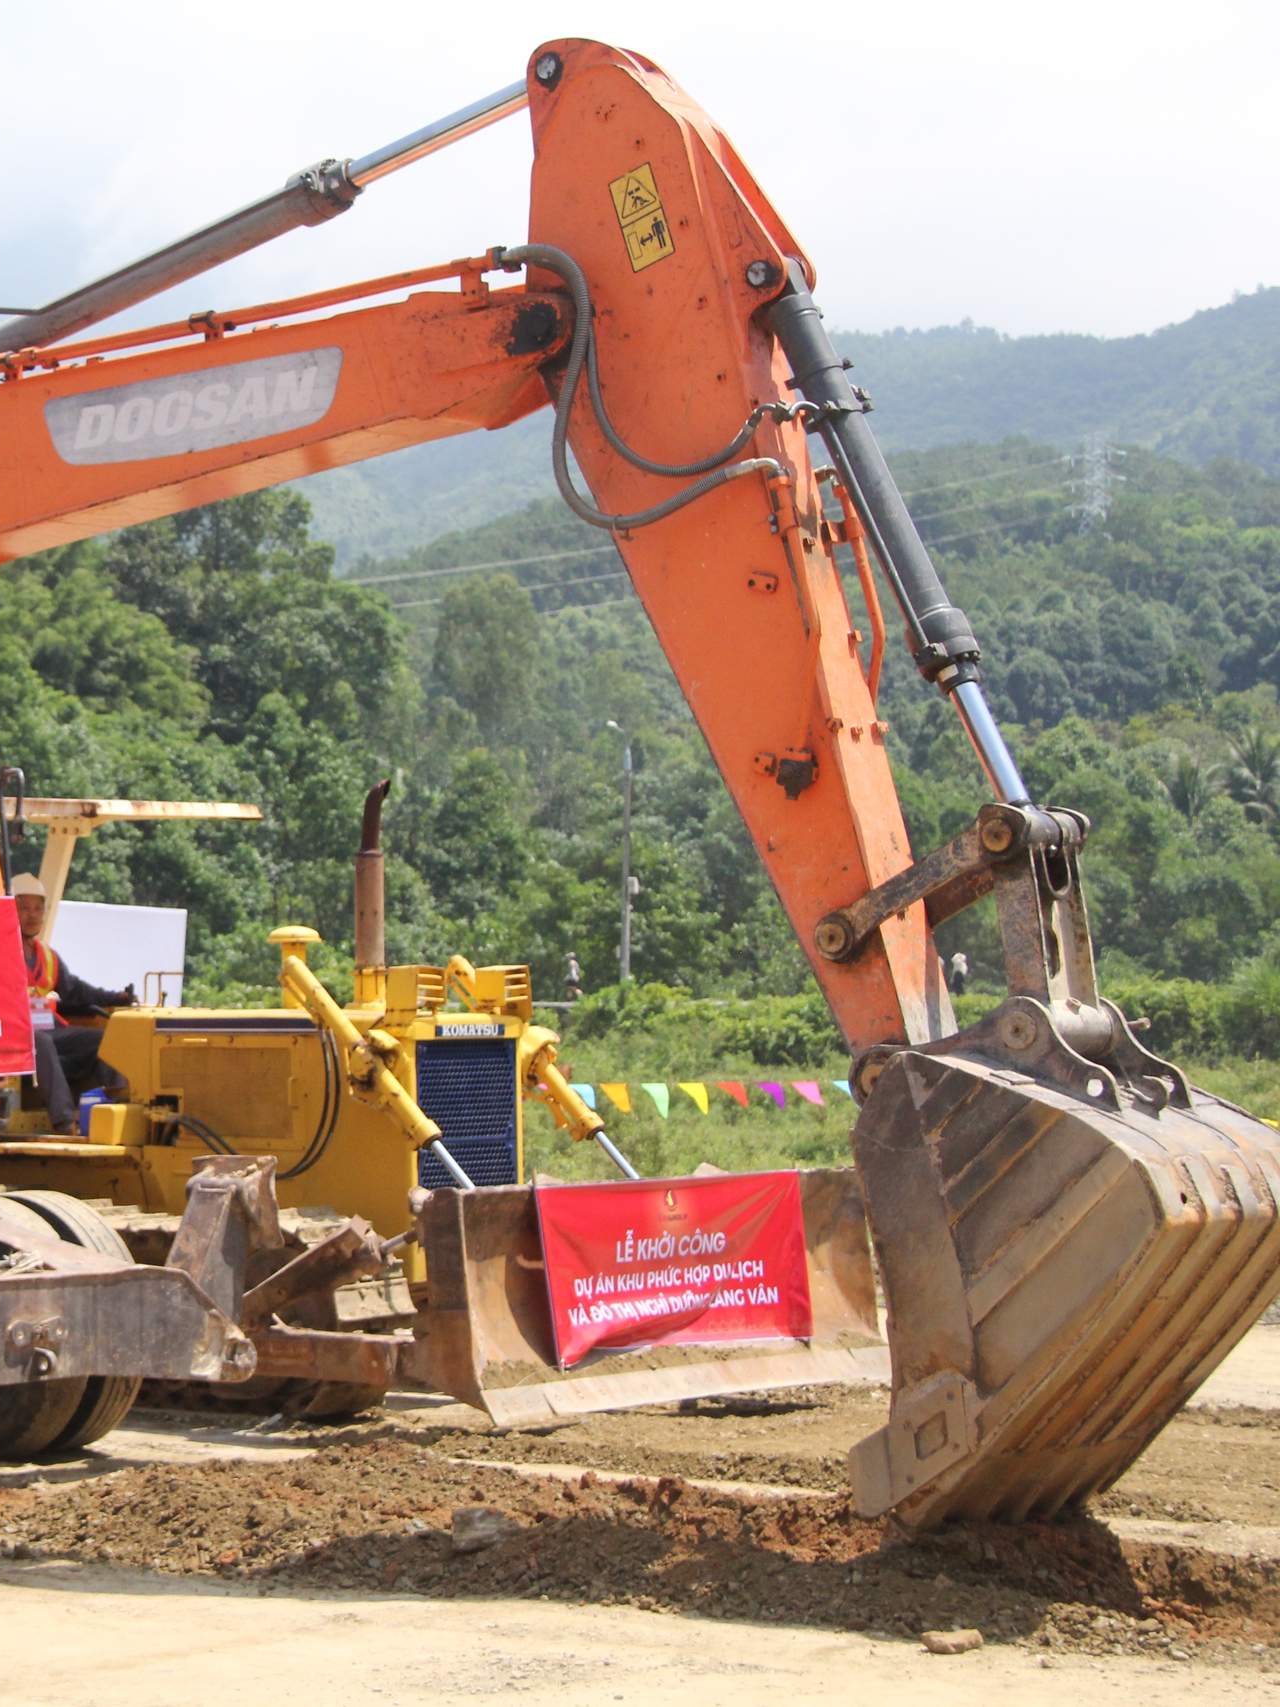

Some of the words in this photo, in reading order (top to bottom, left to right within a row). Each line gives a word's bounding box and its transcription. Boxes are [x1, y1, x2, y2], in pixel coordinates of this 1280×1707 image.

[74, 366, 318, 450] DOOSAN
[441, 1024, 499, 1037] KOMATSU
[616, 1229, 635, 1263] LỄ
[637, 1230, 675, 1260] KHỞI
[678, 1228, 726, 1256] CÔNG
[574, 1275, 594, 1300] DỰ
[595, 1272, 615, 1294] ÁN
[617, 1272, 644, 1292] KHU
[647, 1264, 682, 1288] PHỨC
[684, 1263, 711, 1288] HỢP
[713, 1262, 732, 1282] DU
[731, 1260, 764, 1282] LỊCH
[568, 1302, 591, 1327] VÀ
[589, 1300, 614, 1323] ĐÔ
[610, 1302, 640, 1322] THỊ
[634, 1292, 670, 1317] NGHỈ
[746, 1282, 779, 1305] VÂN
